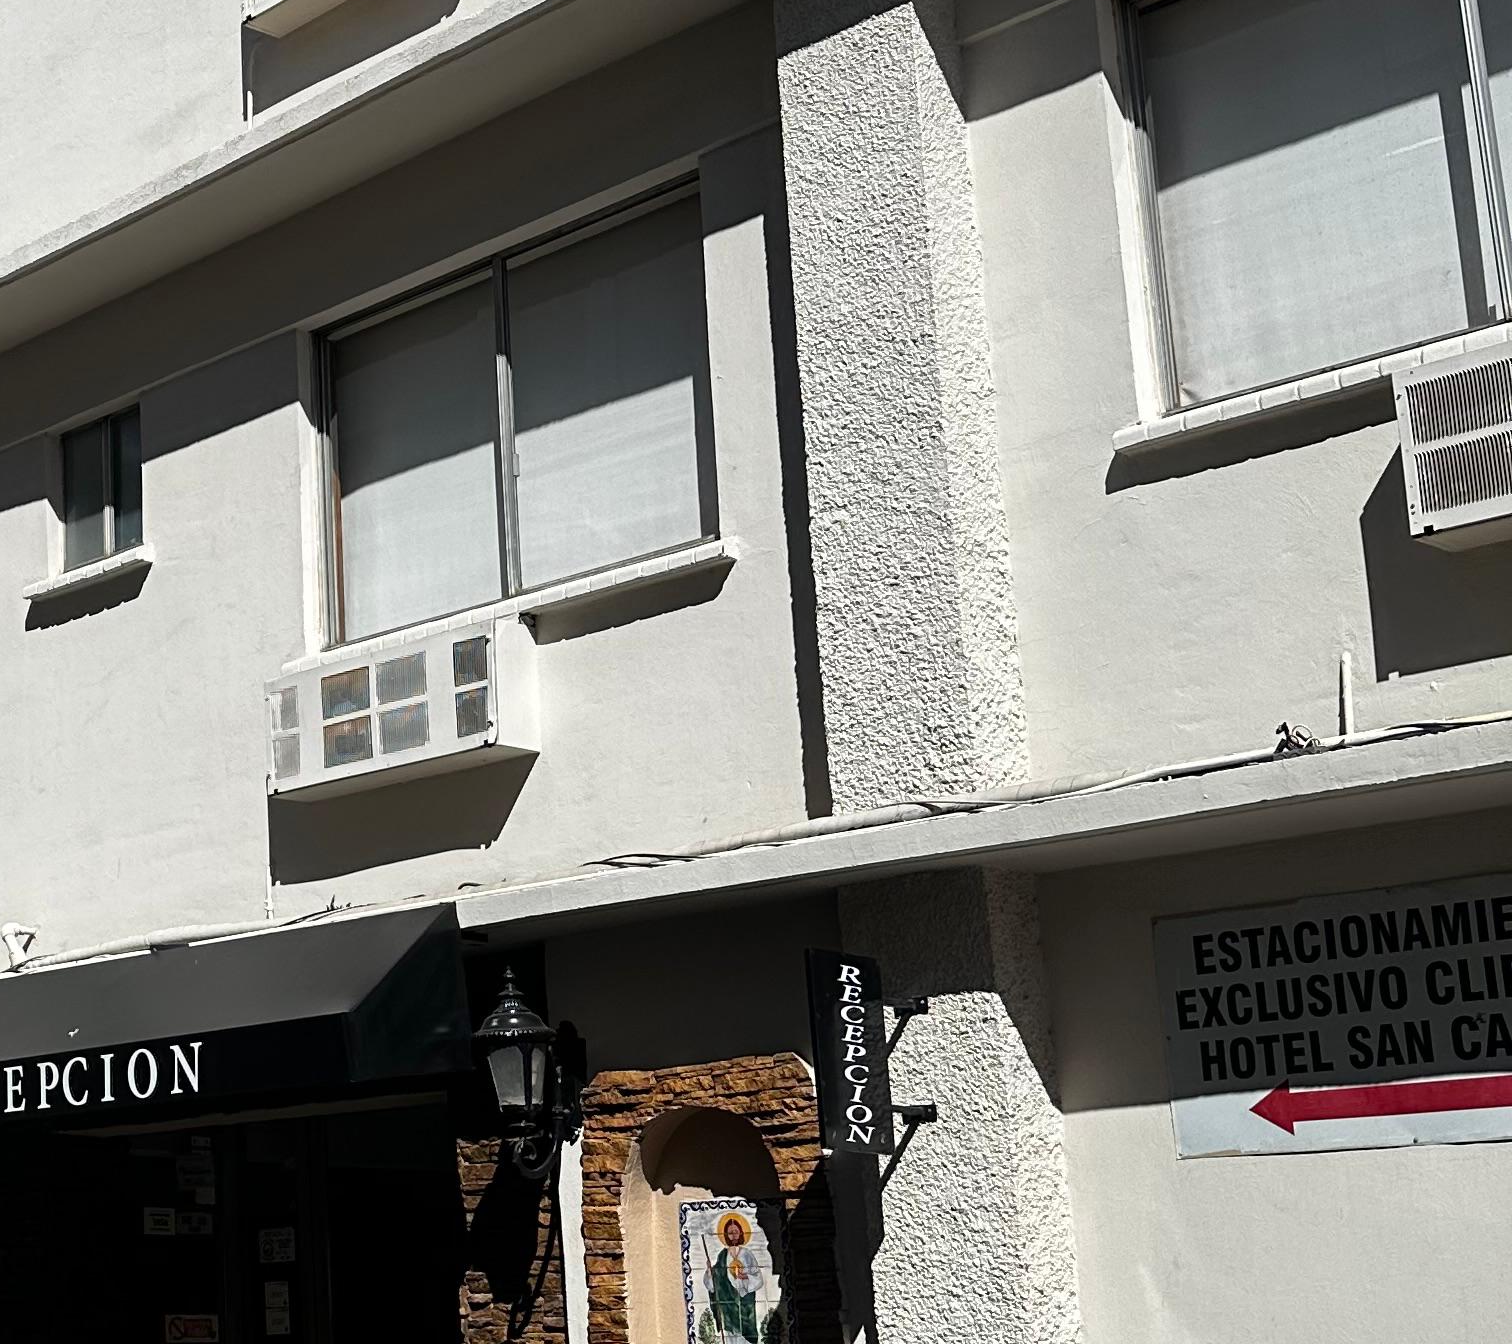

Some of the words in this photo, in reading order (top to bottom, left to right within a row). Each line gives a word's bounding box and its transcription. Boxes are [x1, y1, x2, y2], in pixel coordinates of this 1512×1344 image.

[1192, 895, 1512, 976] ESTACIONAMIE
[1175, 966, 1408, 1031] EXCLUSIVO
[837, 964, 876, 1145] RECEPCION
[1199, 1030, 1334, 1082] HOTEL
[1346, 1019, 1435, 1070] SAN
[1450, 1012, 1512, 1061] CA
